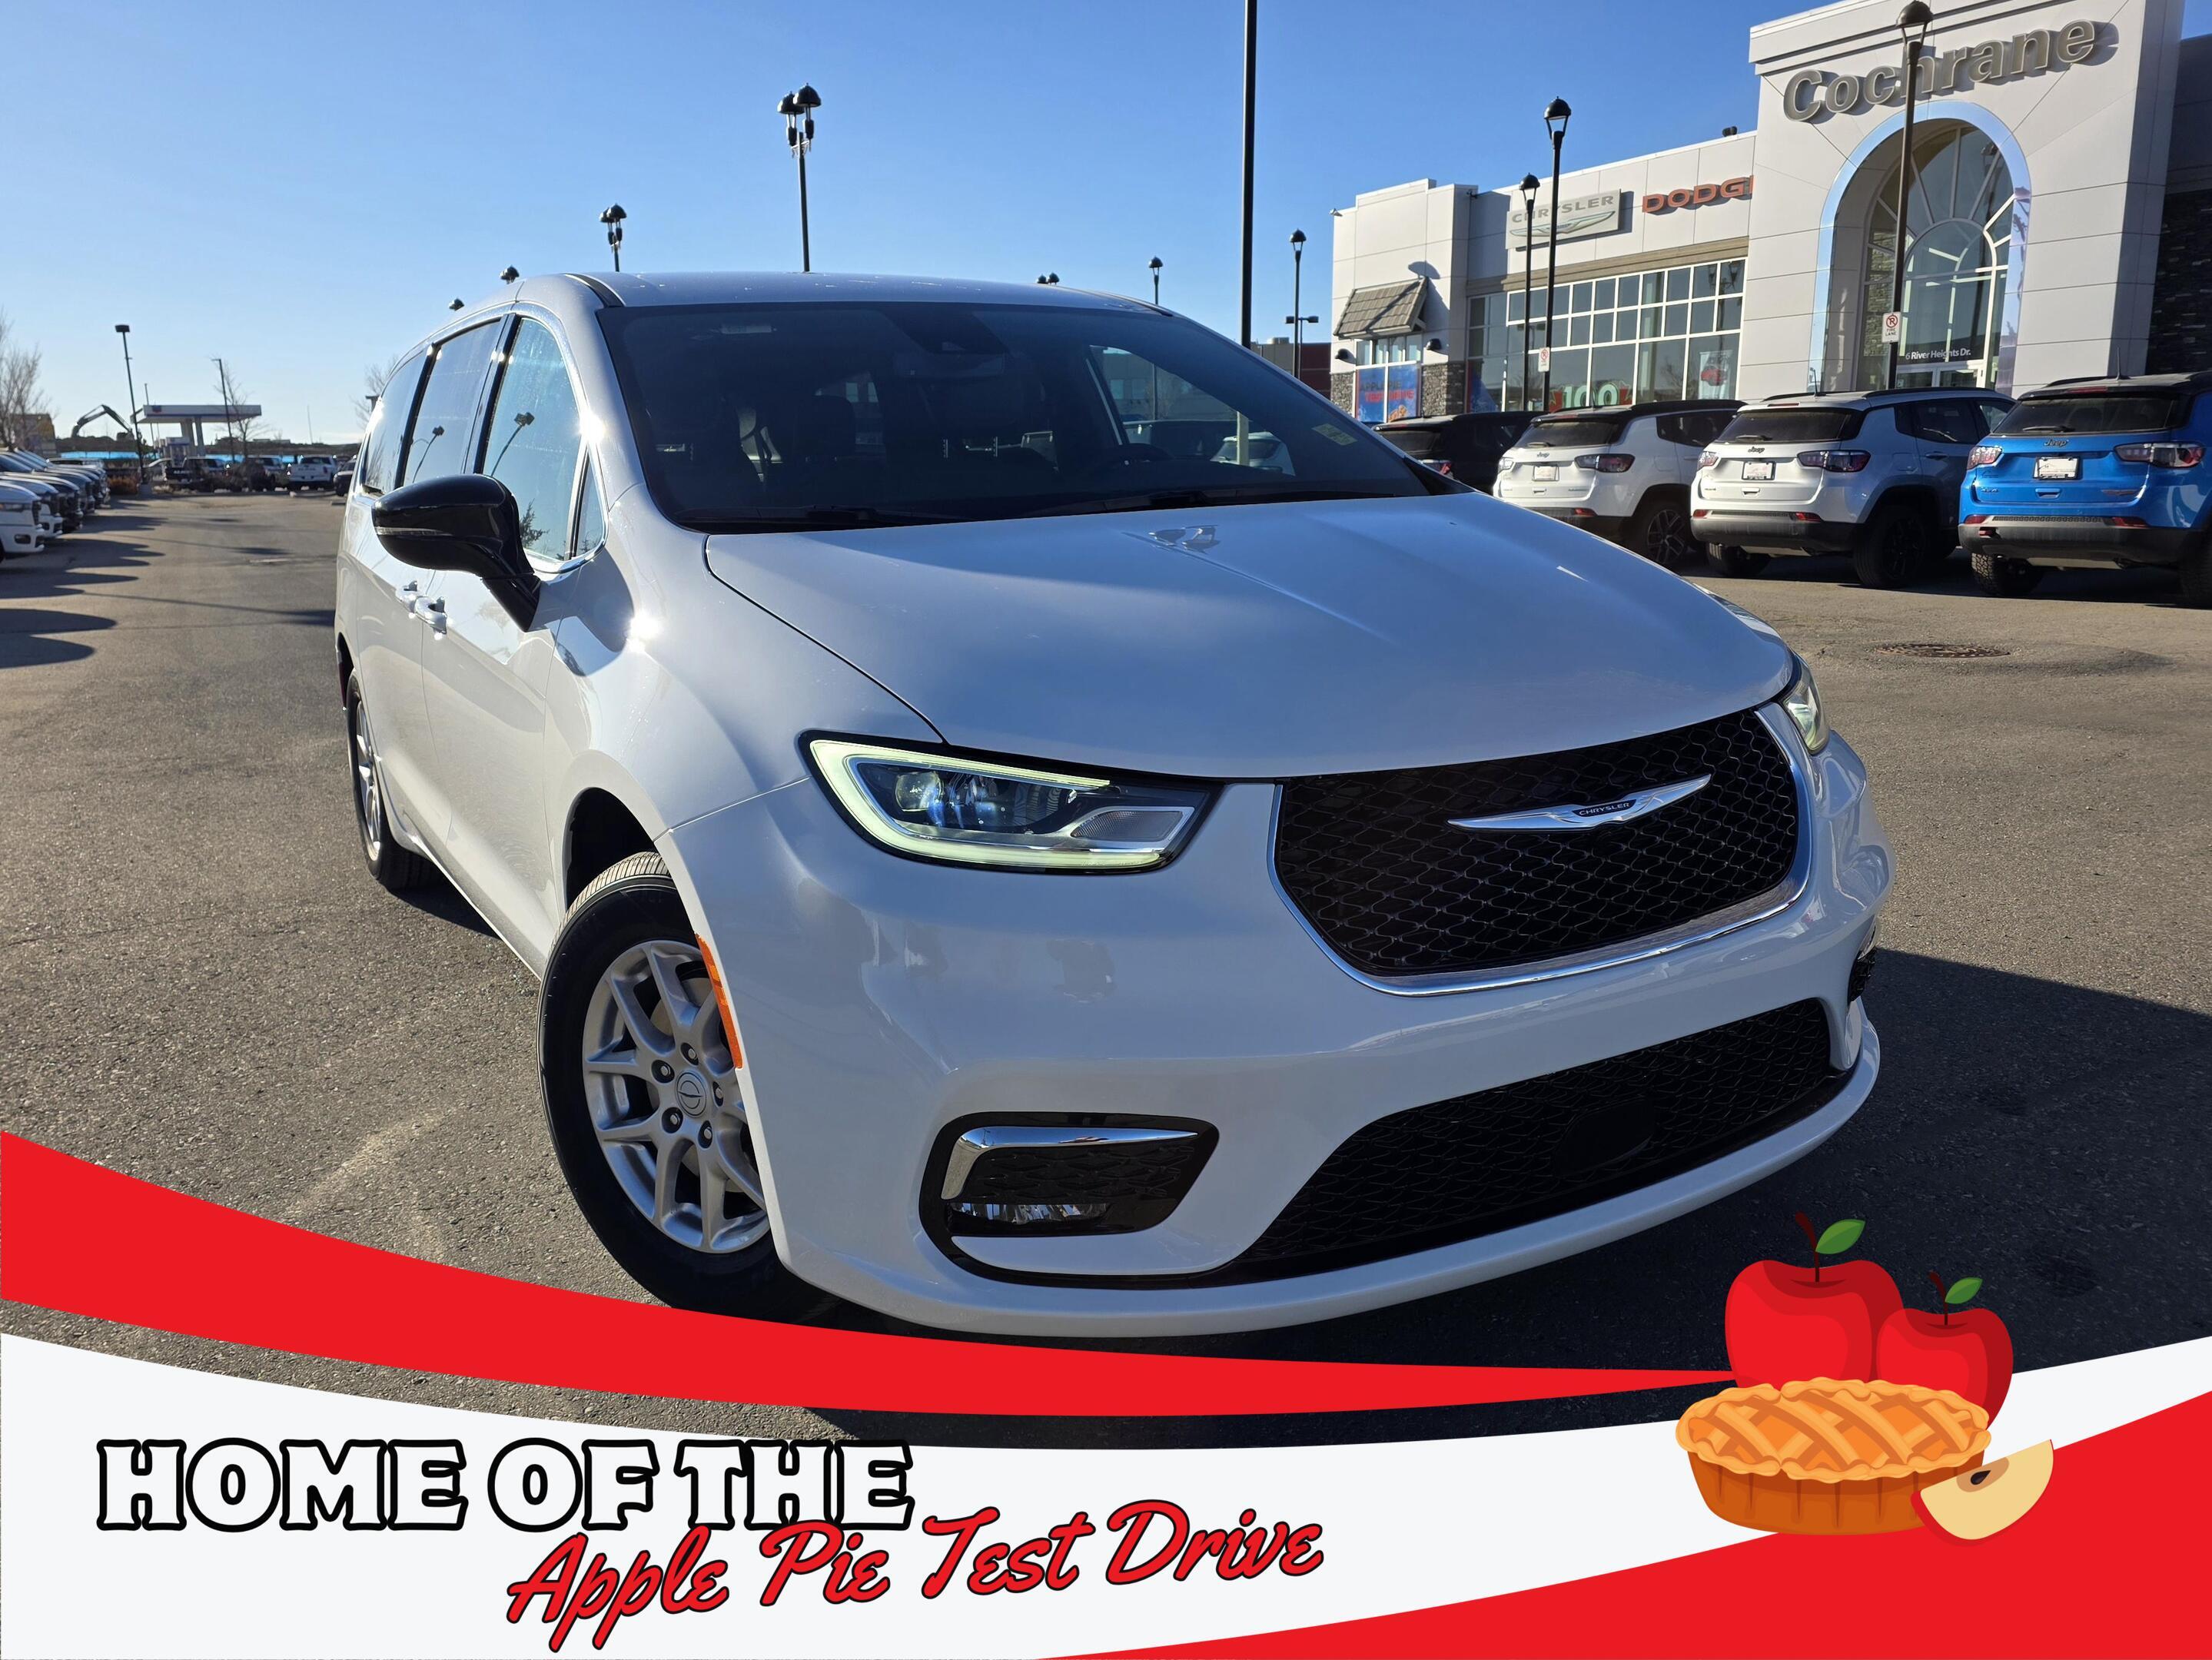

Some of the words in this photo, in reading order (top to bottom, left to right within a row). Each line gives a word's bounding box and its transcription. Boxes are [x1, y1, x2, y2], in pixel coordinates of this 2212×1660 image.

[1782, 18, 2096, 122] Cochrane
[1642, 174, 1754, 213] DODG
[1512, 195, 1614, 223] CHRSLER
[1911, 351, 1930, 360] River
[1960, 348, 1971, 357] Dr.
[1563, 383, 1618, 408] 100
[1579, 802, 1630, 815] CHRYSLER
